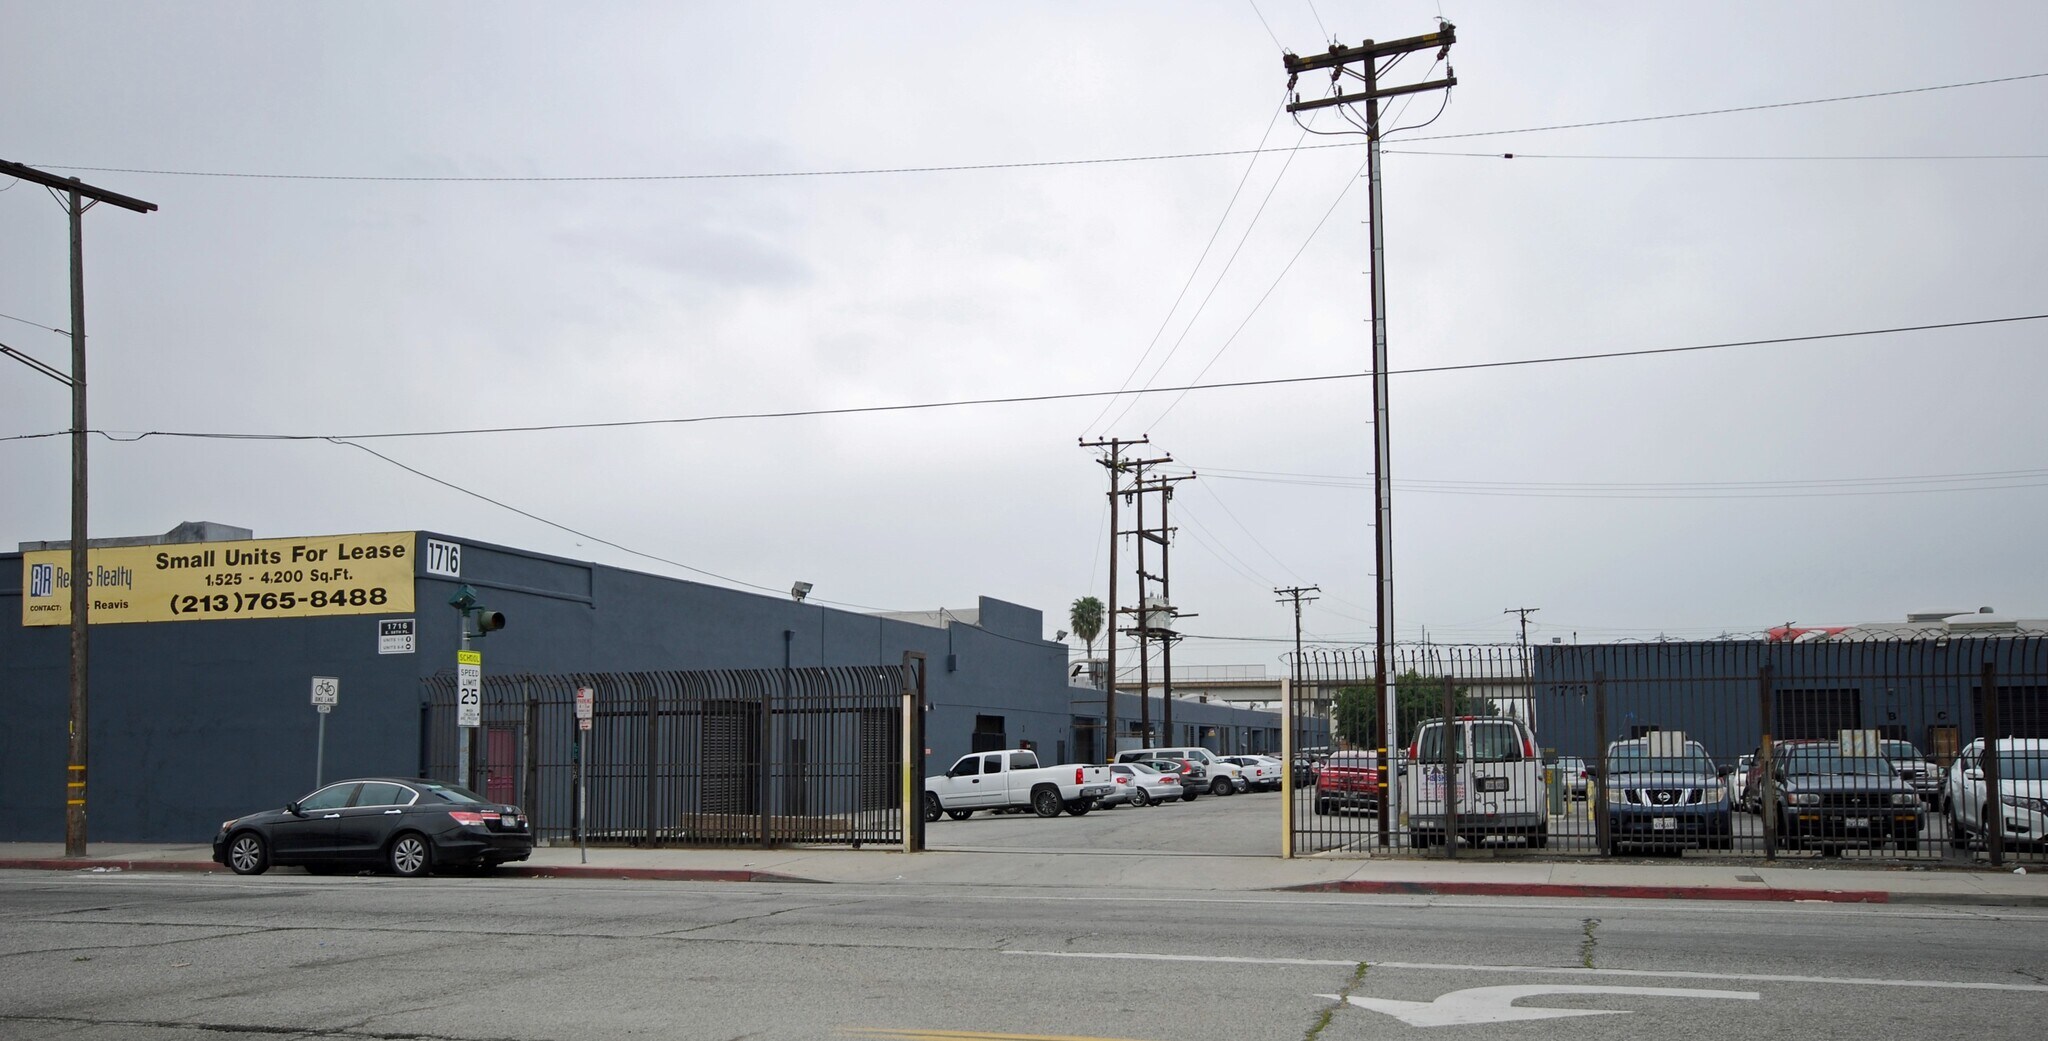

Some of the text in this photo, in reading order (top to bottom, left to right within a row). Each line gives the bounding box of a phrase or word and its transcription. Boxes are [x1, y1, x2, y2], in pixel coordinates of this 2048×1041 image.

[156, 543, 406, 570] Small Units For Lease
[429, 542, 459, 574] 1716
[56, 565, 132, 590] Res Realty
[310, 568, 353, 583] Sq.Ft.
[30, 604, 62, 612] CONTACT:
[94, 600, 129, 610] Reavis
[460, 654, 480, 663] SCHOOL
[461, 669, 479, 677] SPEED
[461, 688, 478, 705] 25
[1888, 712, 1897, 720] B
[1938, 711, 1947, 720] C
